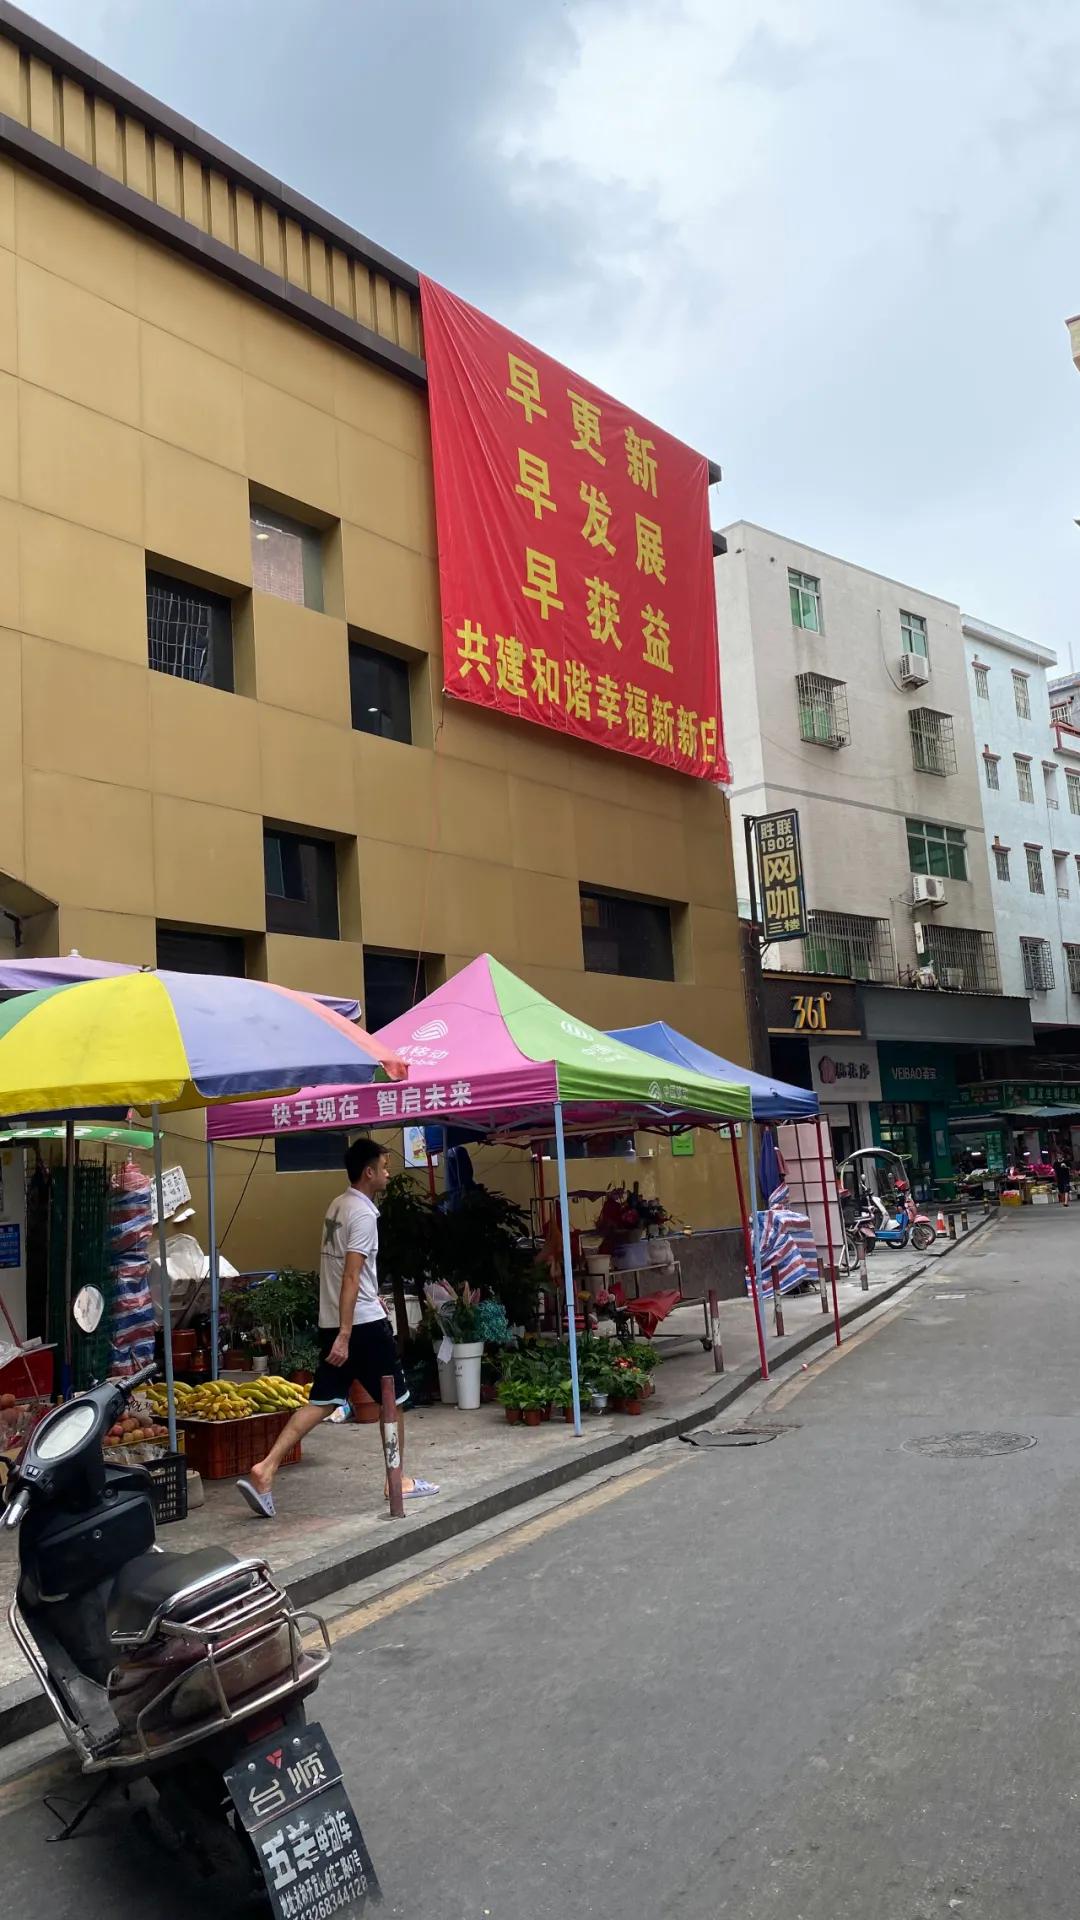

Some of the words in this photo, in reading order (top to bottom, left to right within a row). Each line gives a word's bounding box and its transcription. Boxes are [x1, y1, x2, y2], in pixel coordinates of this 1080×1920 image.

[760, 818, 792, 839] 胜联
[761, 835, 794, 853] 1902
[763, 849, 800, 919] 网咖
[768, 919, 800, 934] 三楼
[377, 1081, 472, 1117] 智启未来
[249, 1752, 328, 1817] 台顺
